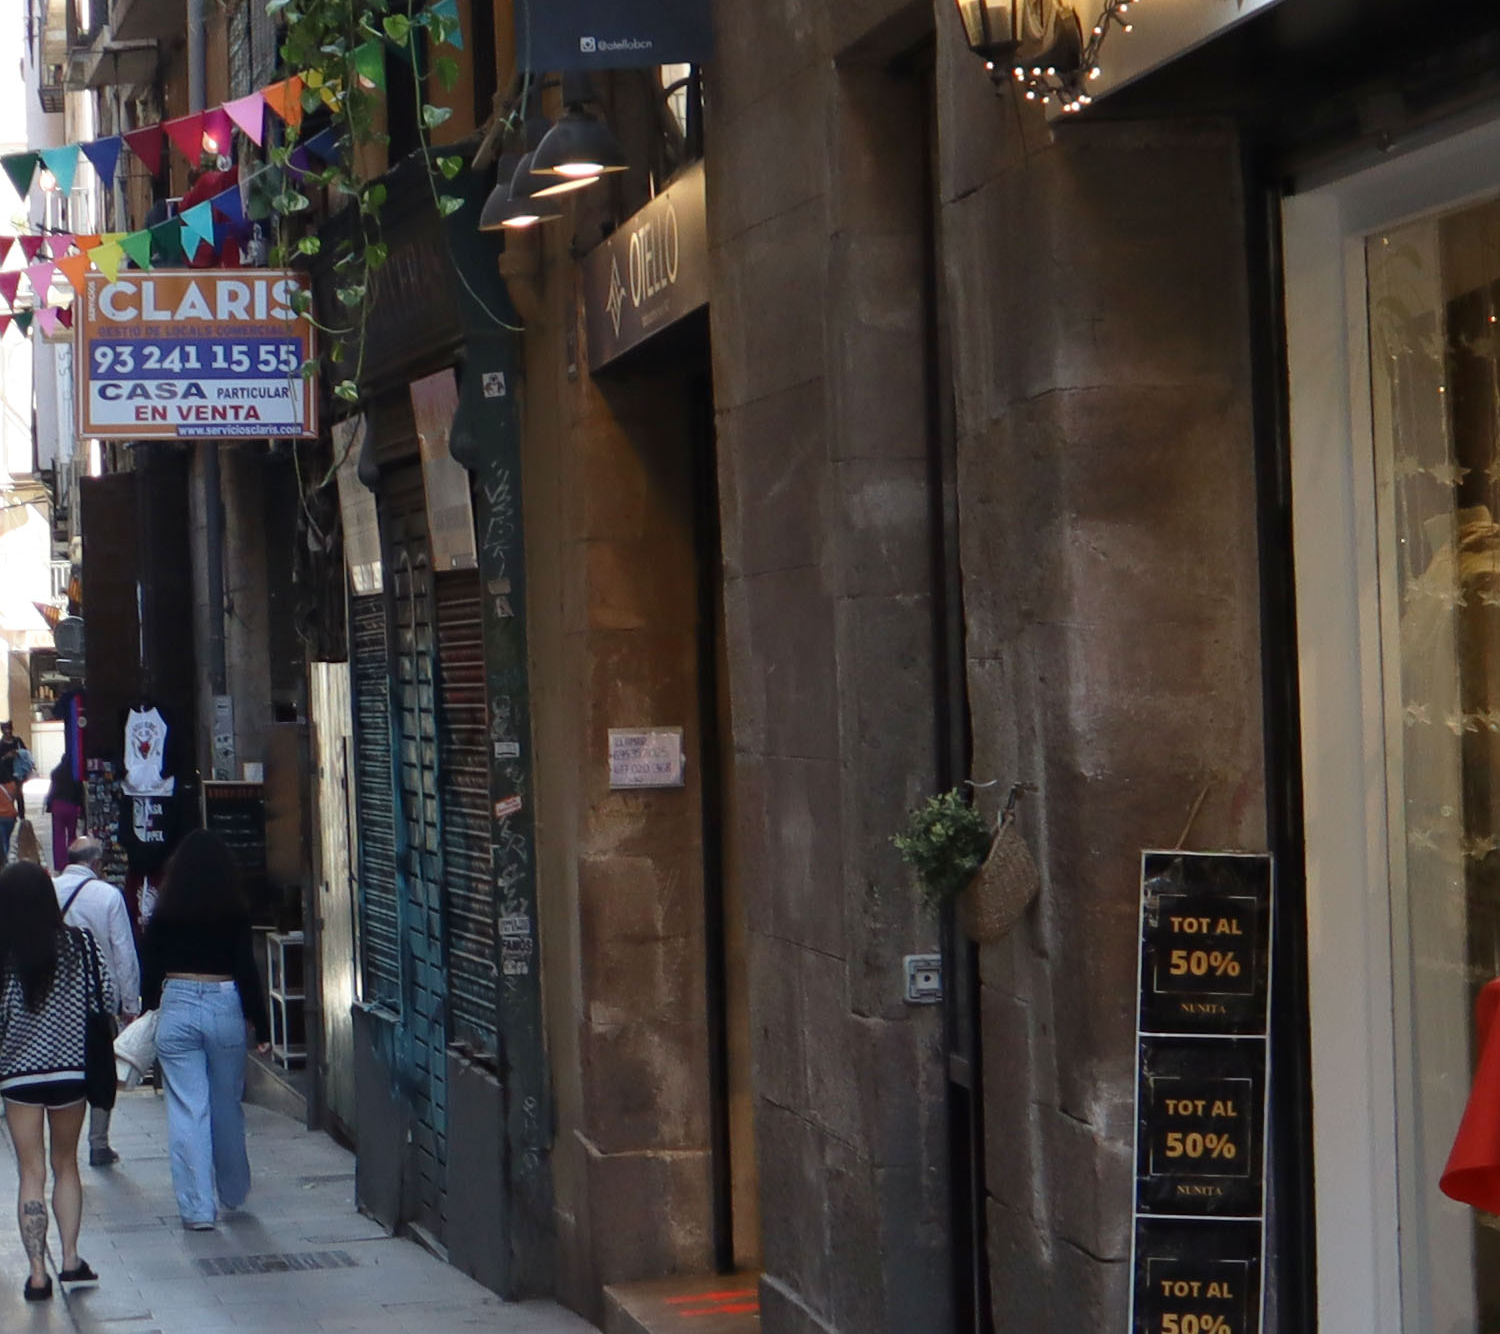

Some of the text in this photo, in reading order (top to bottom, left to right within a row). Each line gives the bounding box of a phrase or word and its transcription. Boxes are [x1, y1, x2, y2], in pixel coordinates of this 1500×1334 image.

[630, 203, 678, 308] OTELLO
[99, 279, 301, 321] CLARIS
[94, 345, 298, 373] 93 241 15 55
[98, 382, 290, 401] CASA PARTICULAR
[135, 405, 261, 421] EN VENTA
[179, 424, 302, 436] www.serviciosclaris.com
[1170, 917, 1242, 935] TOT AL
[1169, 949, 1241, 977] 50%
[1181, 1003, 1227, 1014] NUNITA
[1165, 1099, 1237, 1117] TOT AL
[1165, 1132, 1236, 1159] 50%
[1177, 1185, 1223, 1196] NUNITA
[1161, 1280, 1233, 1299] TOT AL
